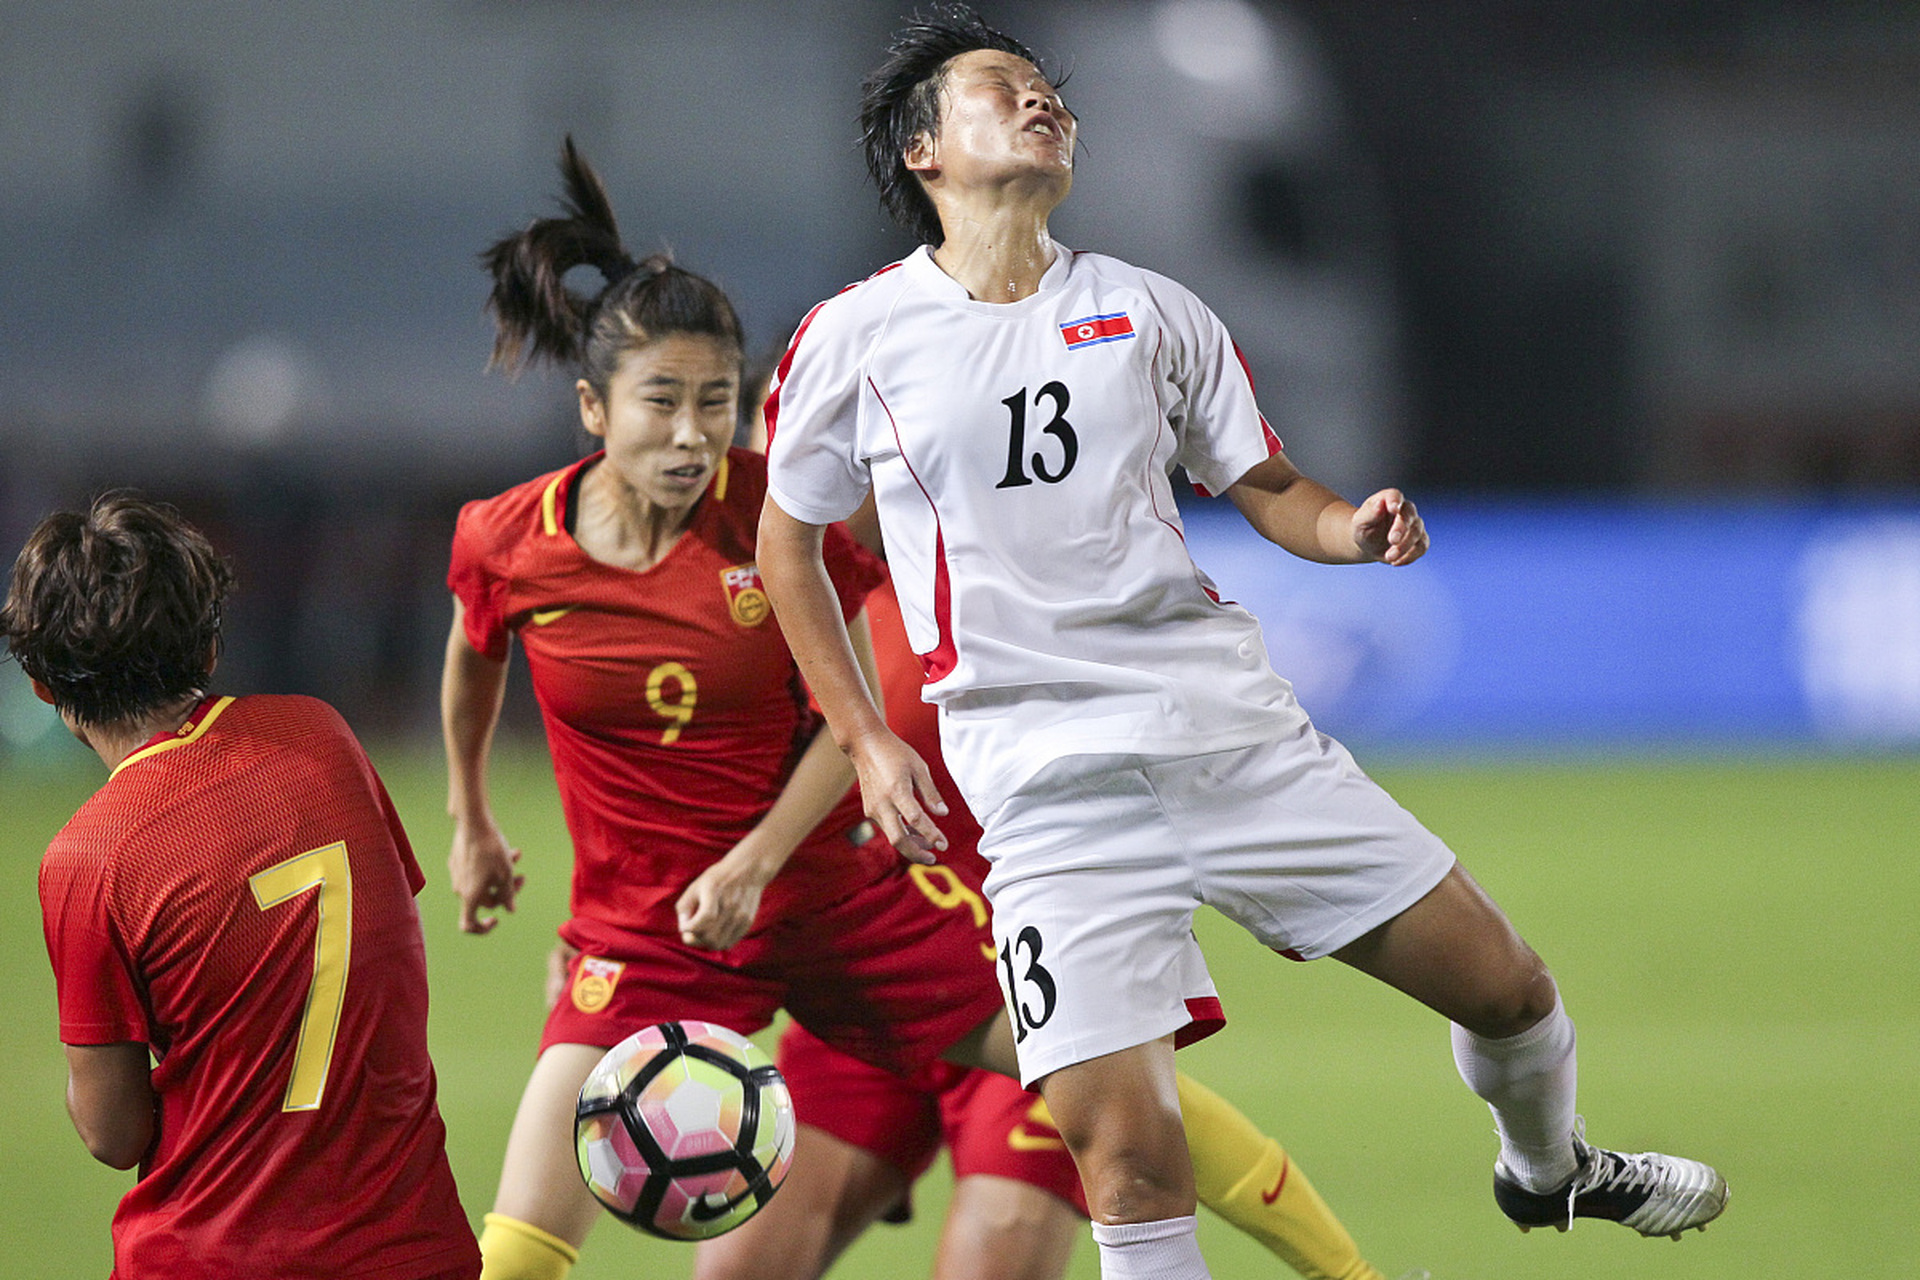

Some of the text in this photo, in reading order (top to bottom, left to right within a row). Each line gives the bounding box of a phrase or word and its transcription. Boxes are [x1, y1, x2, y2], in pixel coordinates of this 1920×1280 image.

[995, 380, 1078, 489] 13
[646, 661, 697, 745] 9
[909, 863, 988, 928] 9
[248, 840, 352, 1112] 7
[1000, 925, 1057, 1045] 13
